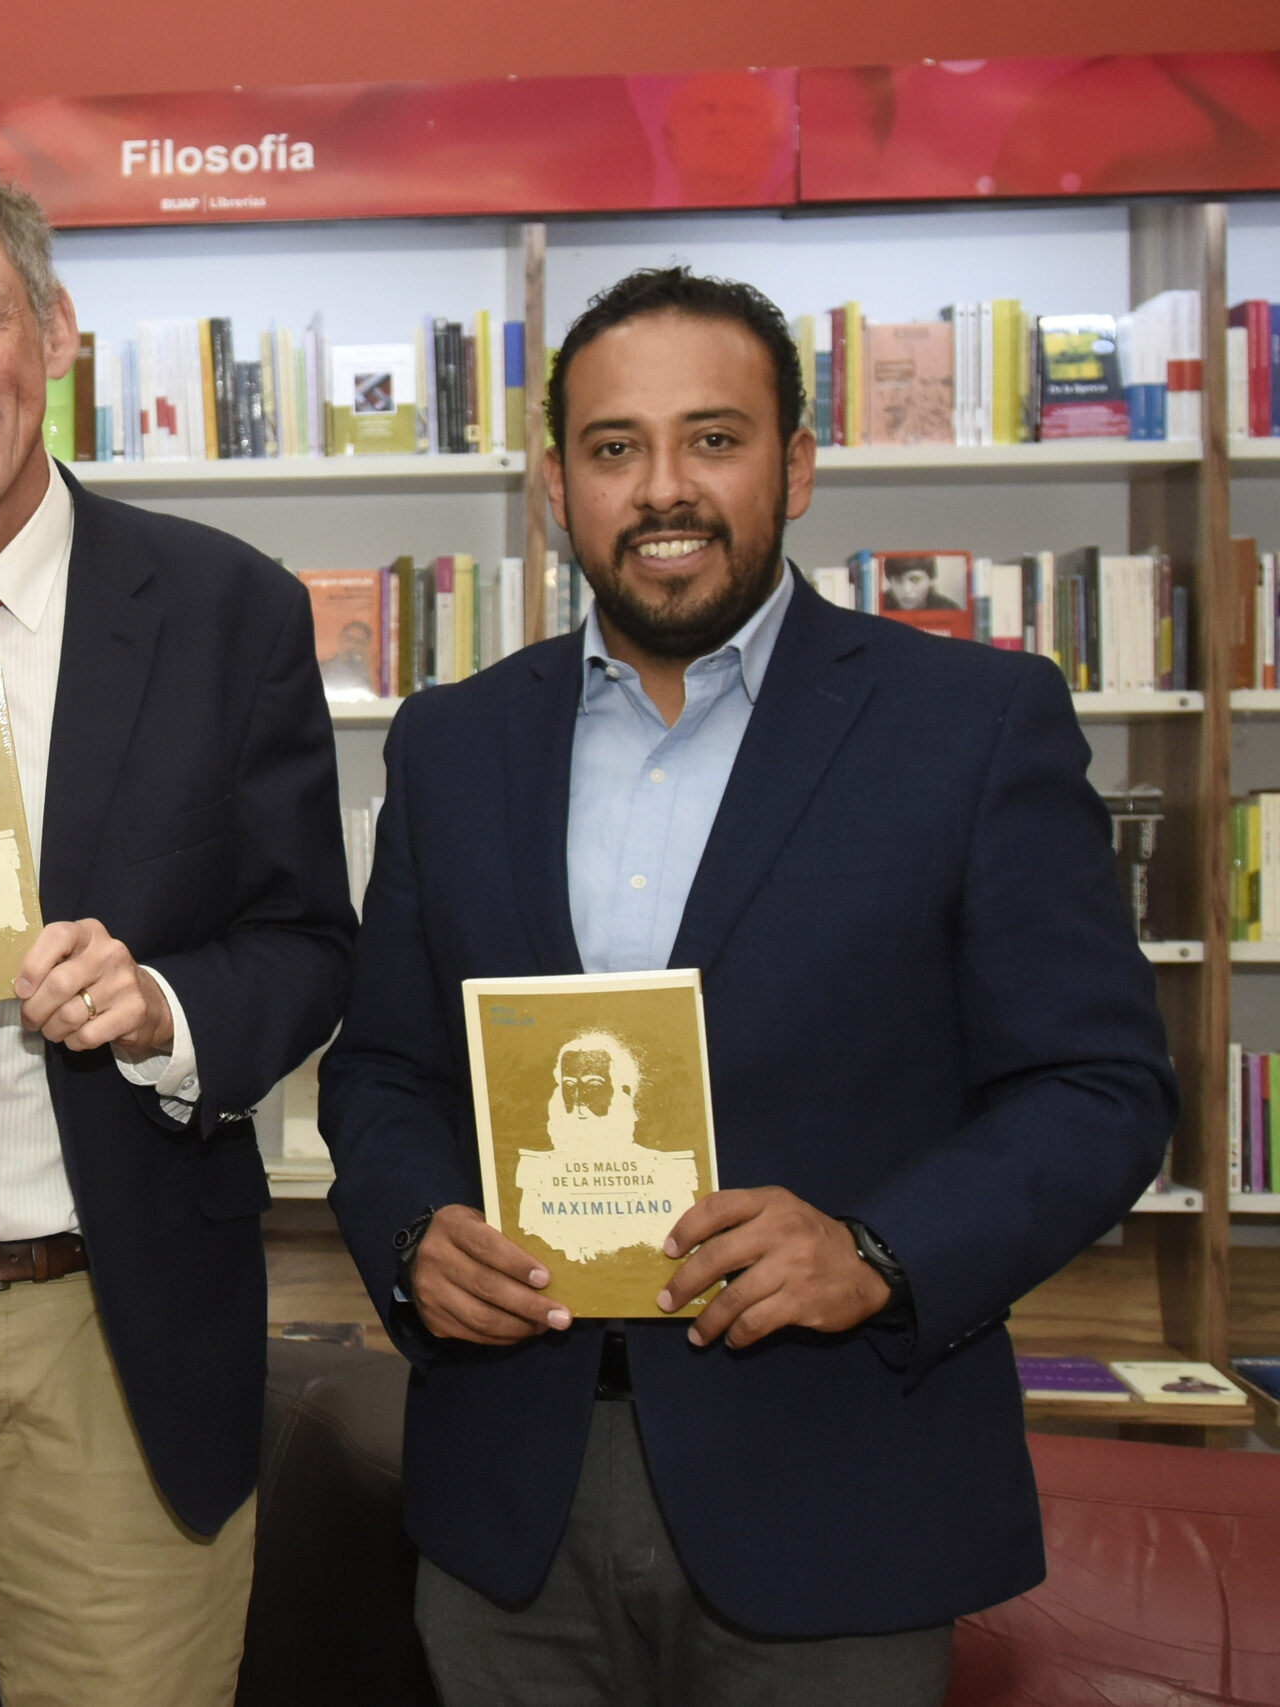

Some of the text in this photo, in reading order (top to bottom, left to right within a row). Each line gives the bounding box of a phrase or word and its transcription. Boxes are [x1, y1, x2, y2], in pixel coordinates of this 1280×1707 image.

[122, 133, 315, 177] Filosofía
[160, 197, 200, 211] BUAP
[565, 1161, 638, 1173] LOS MALOS
[552, 1175, 655, 1187] DE LA HISTORIA
[541, 1199, 672, 1215] MAXIMILIANO
